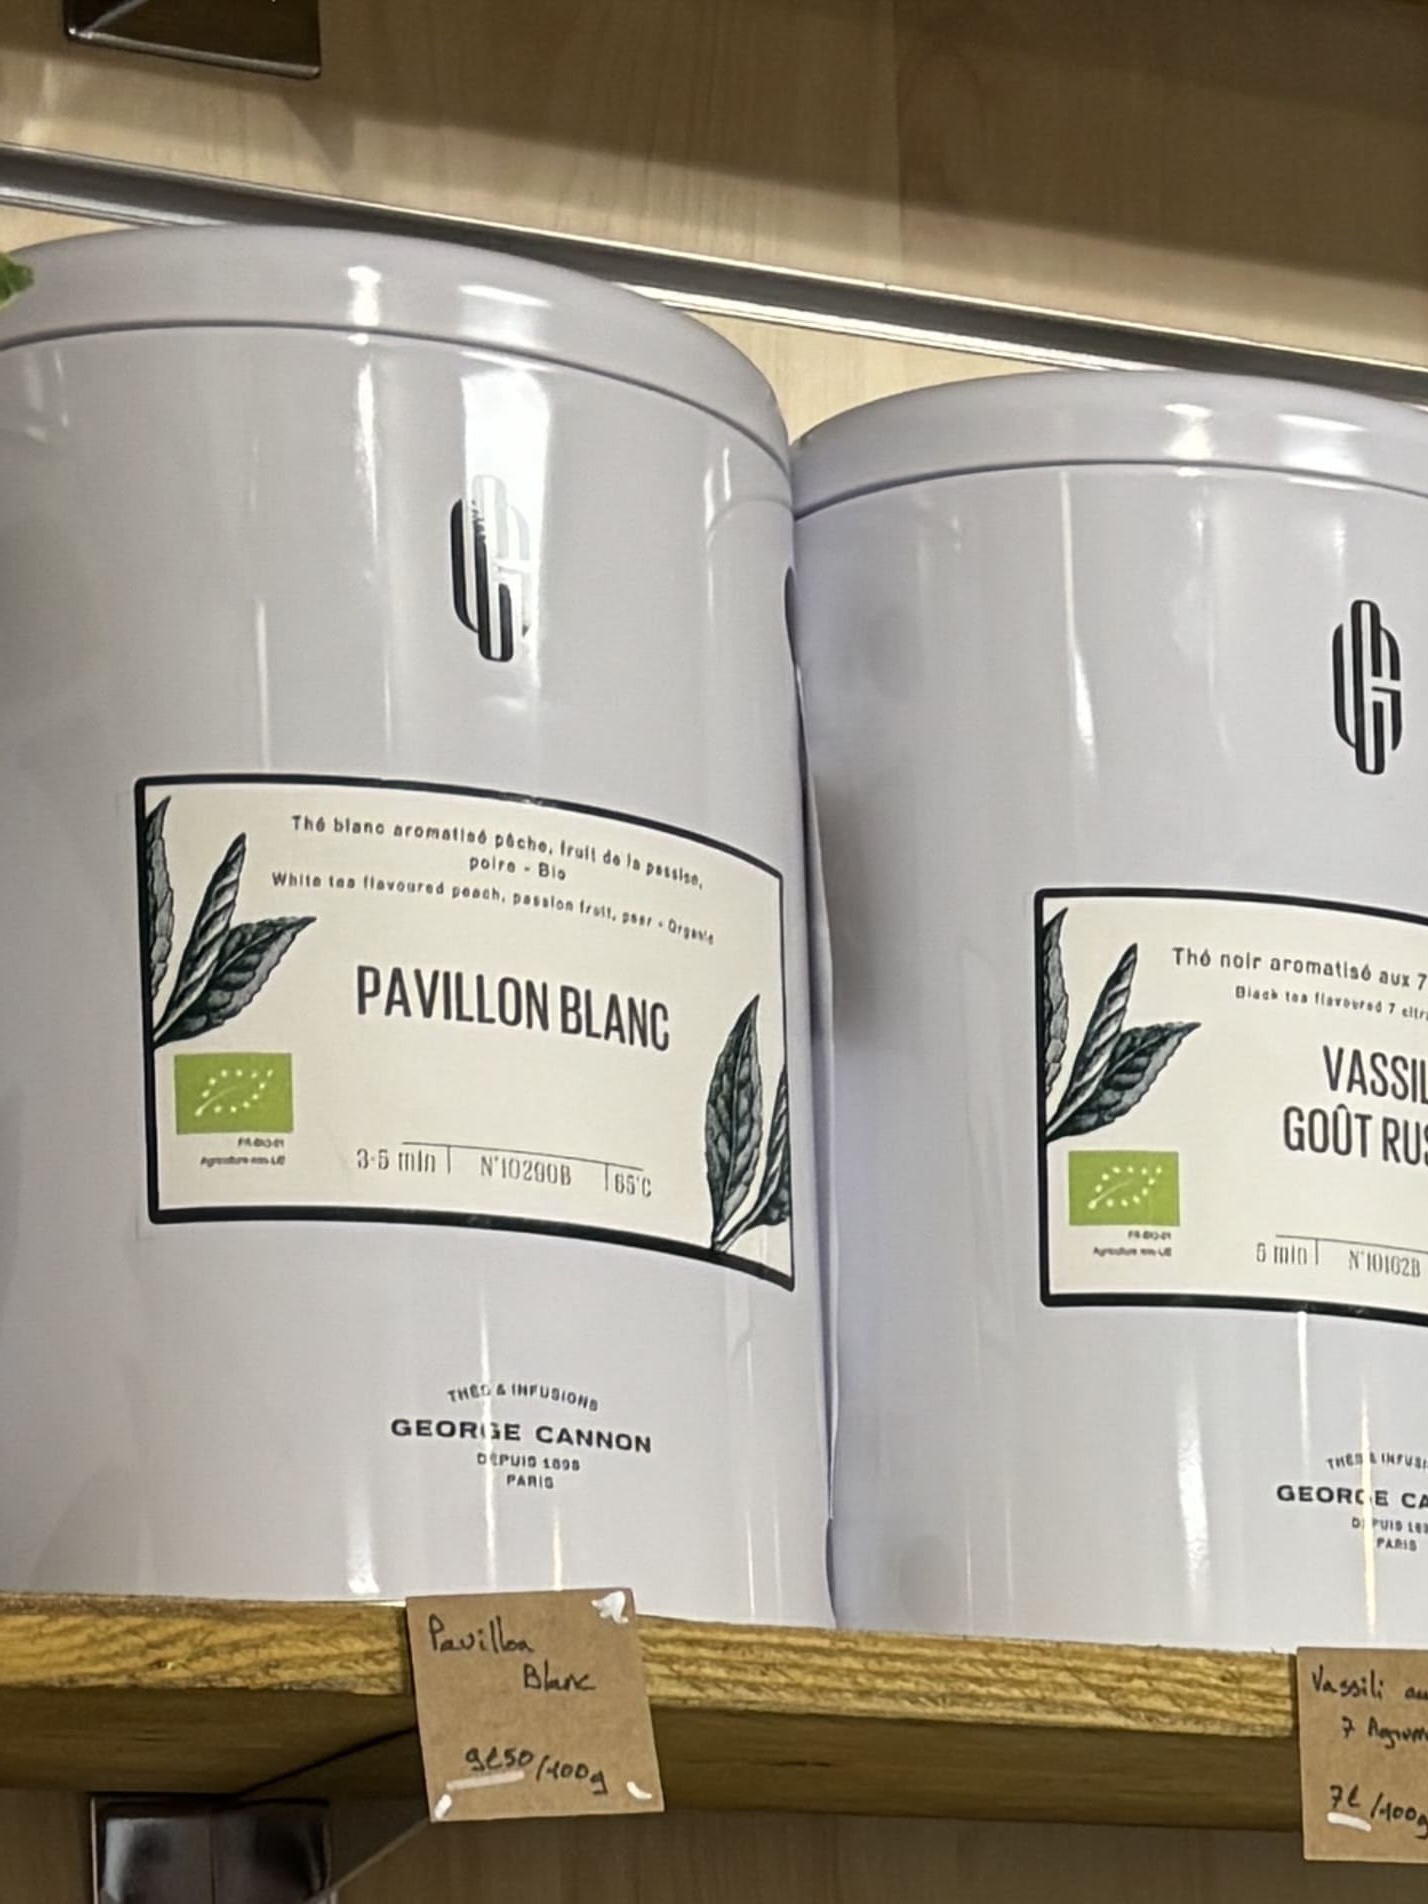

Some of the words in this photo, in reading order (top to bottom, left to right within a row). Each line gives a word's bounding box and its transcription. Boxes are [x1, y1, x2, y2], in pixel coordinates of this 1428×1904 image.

[292, 815, 325, 832] Thé
[334, 818, 384, 834] blanc
[394, 825, 487, 844] aromatisé
[561, 840, 595, 862] fruit
[603, 850, 620, 866] de
[470, 857, 515, 873] poire
[539, 862, 566, 880] Bio
[1172, 947, 1211, 967] Thé
[1221, 952, 1261, 969] noir
[1270, 958, 1371, 981] aromatisé
[1379, 971, 1409, 987] aux
[1418, 973, 1427, 990] 7
[357, 965, 549, 1031] PAVILLON
[561, 985, 669, 1051] BLANC
[1284, 1104, 1372, 1158] GOÛT
[399, 1150, 435, 1172] min
[391, 1419, 520, 1441] GEORGE
[536, 1426, 651, 1453] CANNON
[507, 1474, 553, 1489] PARIS
[429, 1614, 534, 1654] Pavillon
[524, 1659, 596, 1691] Blanc
[1312, 1664, 1383, 1700] Vassili
[1342, 1716, 1355, 1738] 7
